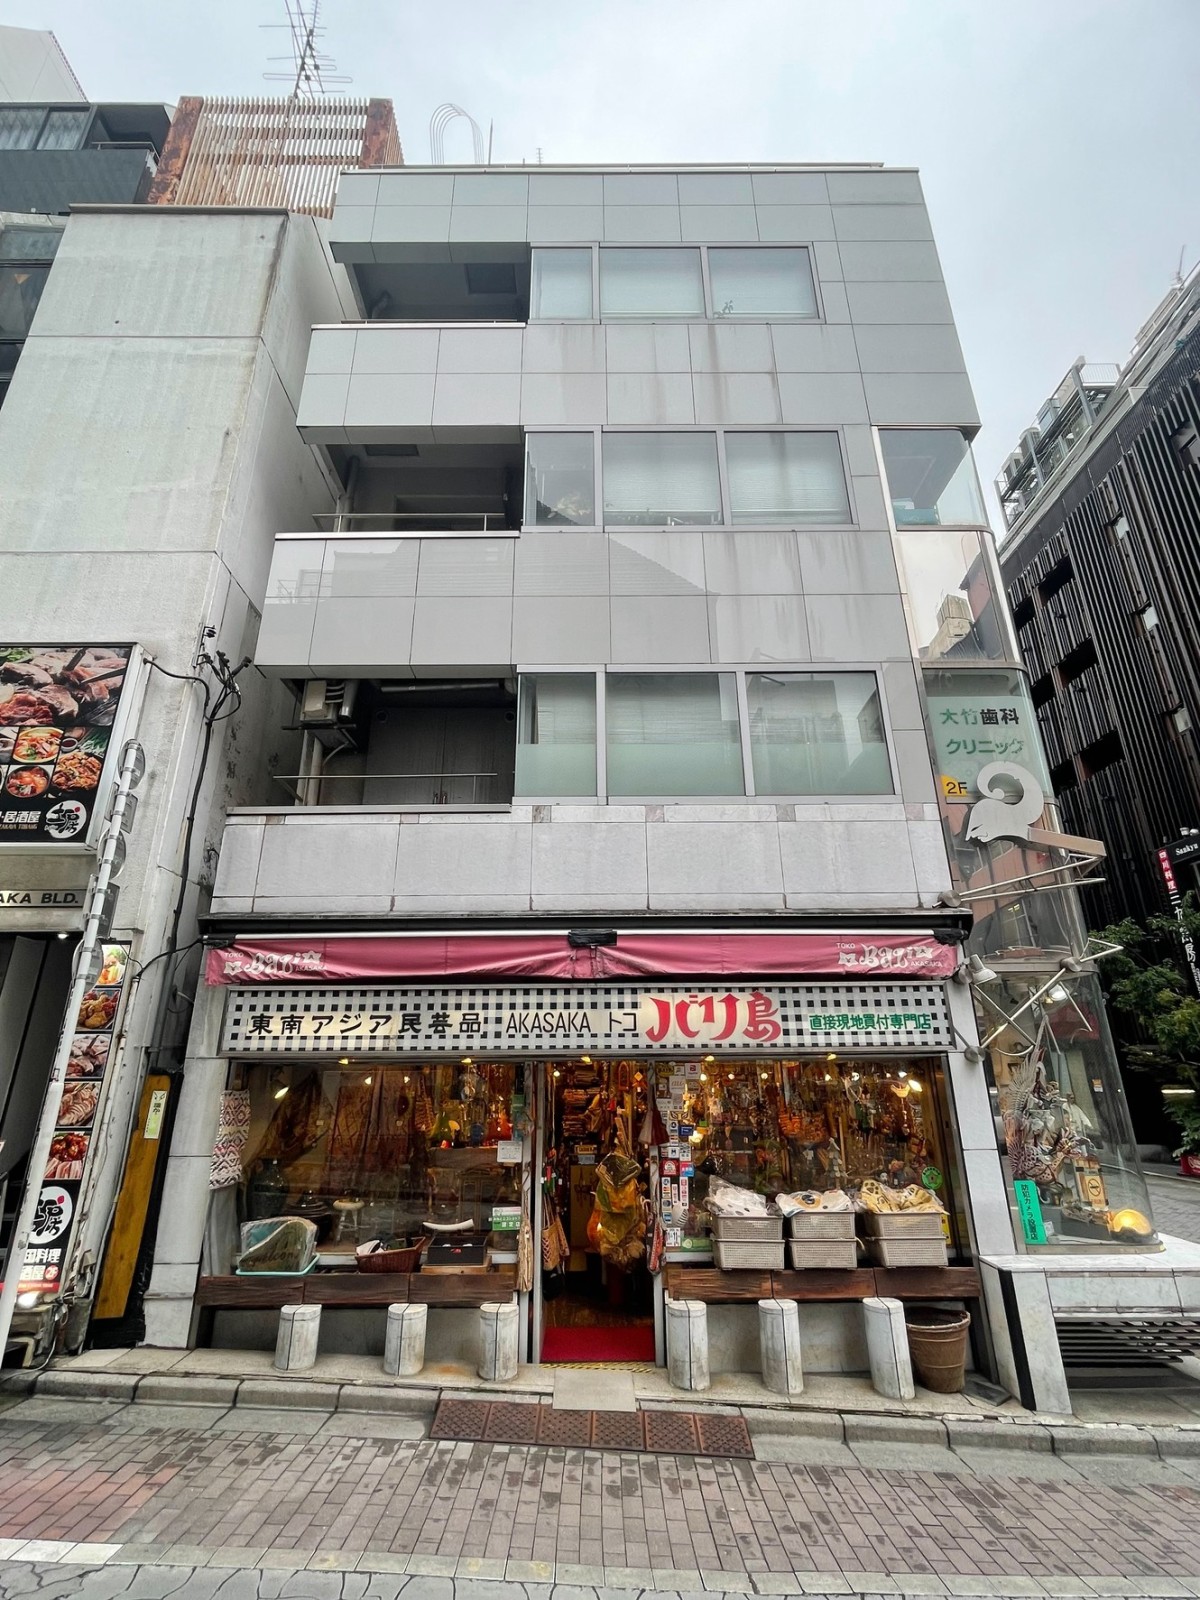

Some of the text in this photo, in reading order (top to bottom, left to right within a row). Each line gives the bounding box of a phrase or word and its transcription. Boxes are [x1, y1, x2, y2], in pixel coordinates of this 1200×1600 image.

[940, 708, 1019, 725] 大竹歯科
[946, 739, 1024, 755] クリニック
[946, 782, 968, 794] 2F
[0, 811, 41, 823] ・居酒屋
[41, 893, 78, 903] BLD.
[248, 990, 932, 1043] 東南アジア民芸品 AKASAKA トコ バリ島 直接現地買付専門店
